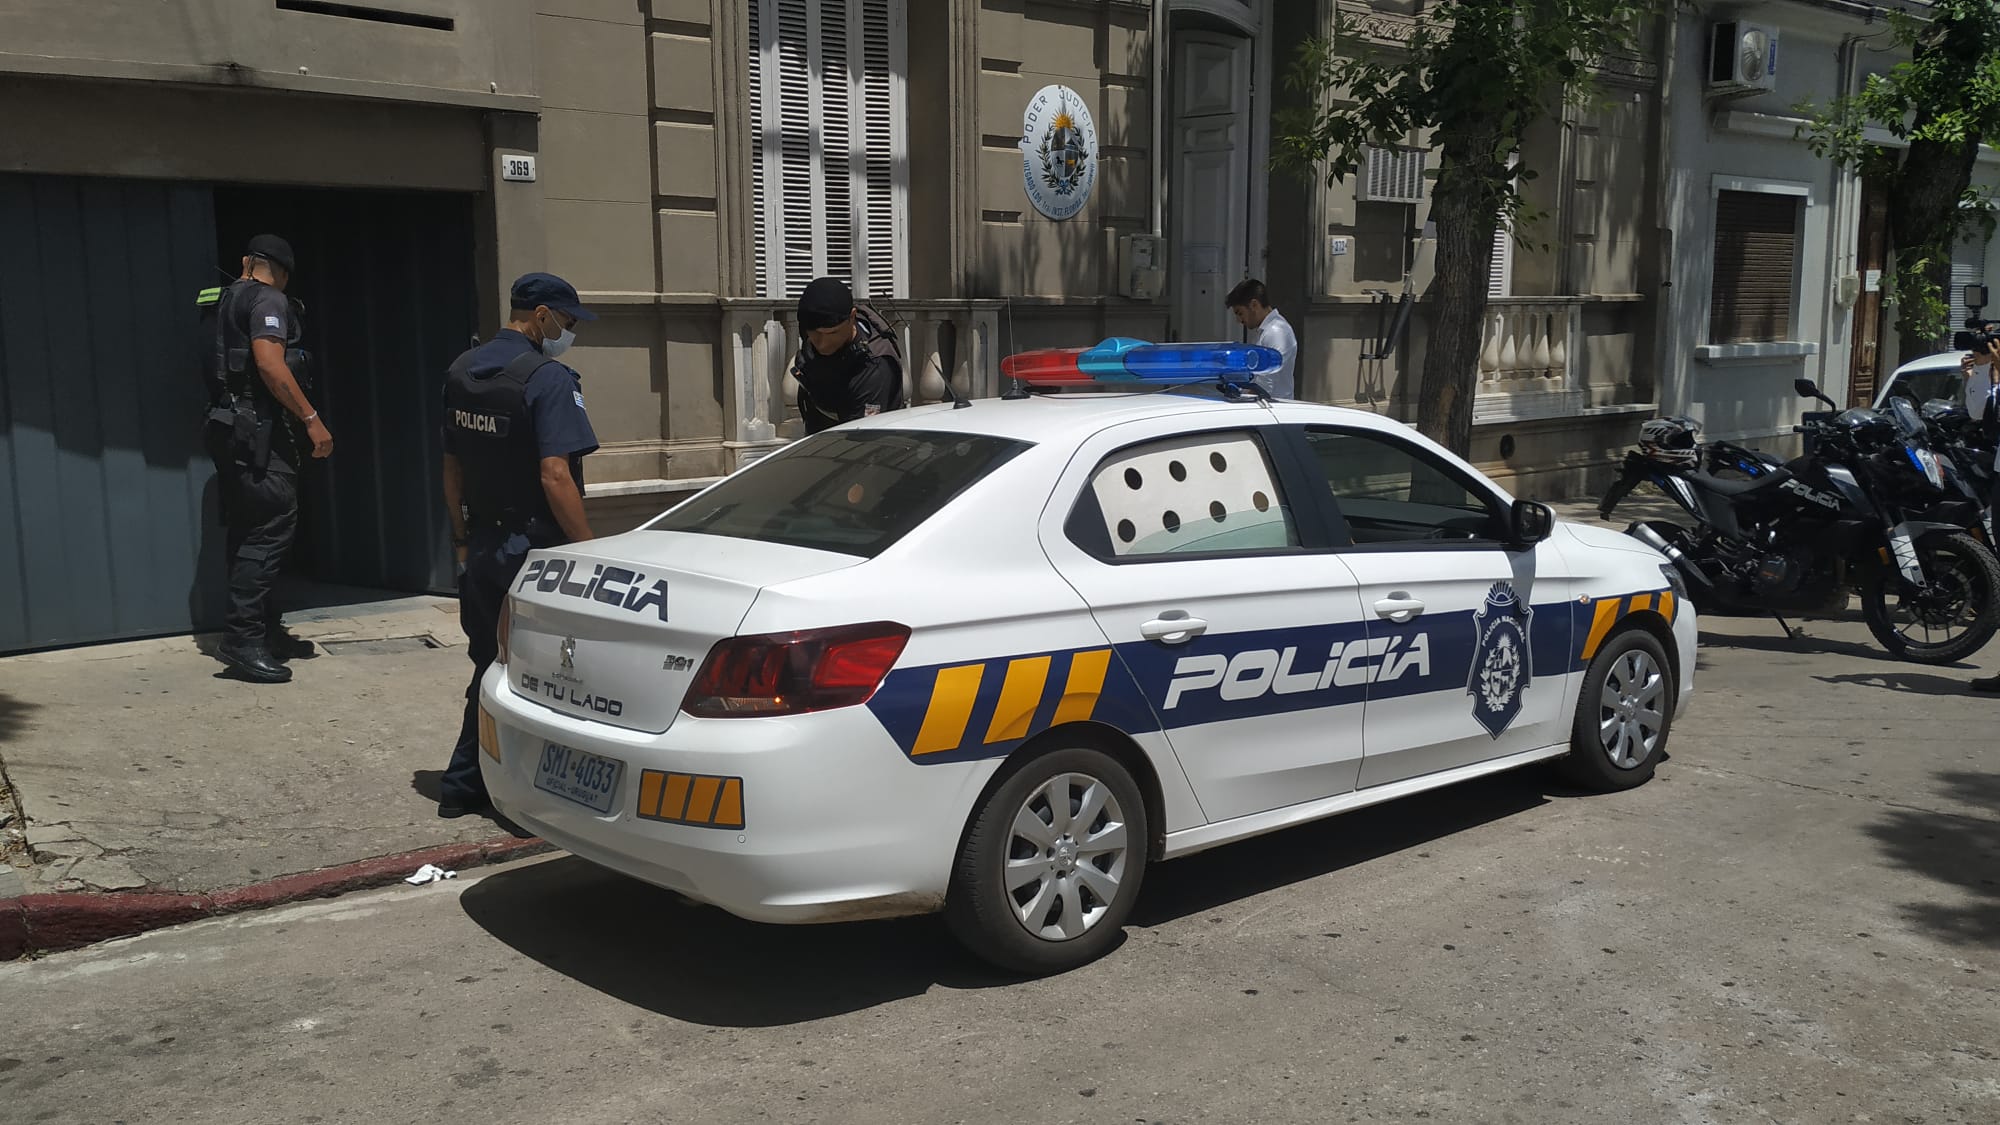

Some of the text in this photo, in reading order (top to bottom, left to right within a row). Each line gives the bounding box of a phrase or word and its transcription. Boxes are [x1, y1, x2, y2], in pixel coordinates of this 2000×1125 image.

[1022, 89, 1095, 150] PODER JUDICIAL
[510, 160, 529, 176] 369
[455, 410, 497, 433] POLICIA
[521, 673, 539, 692] DE
[544, 681, 565, 700] TU
[570, 689, 623, 716] LADO
